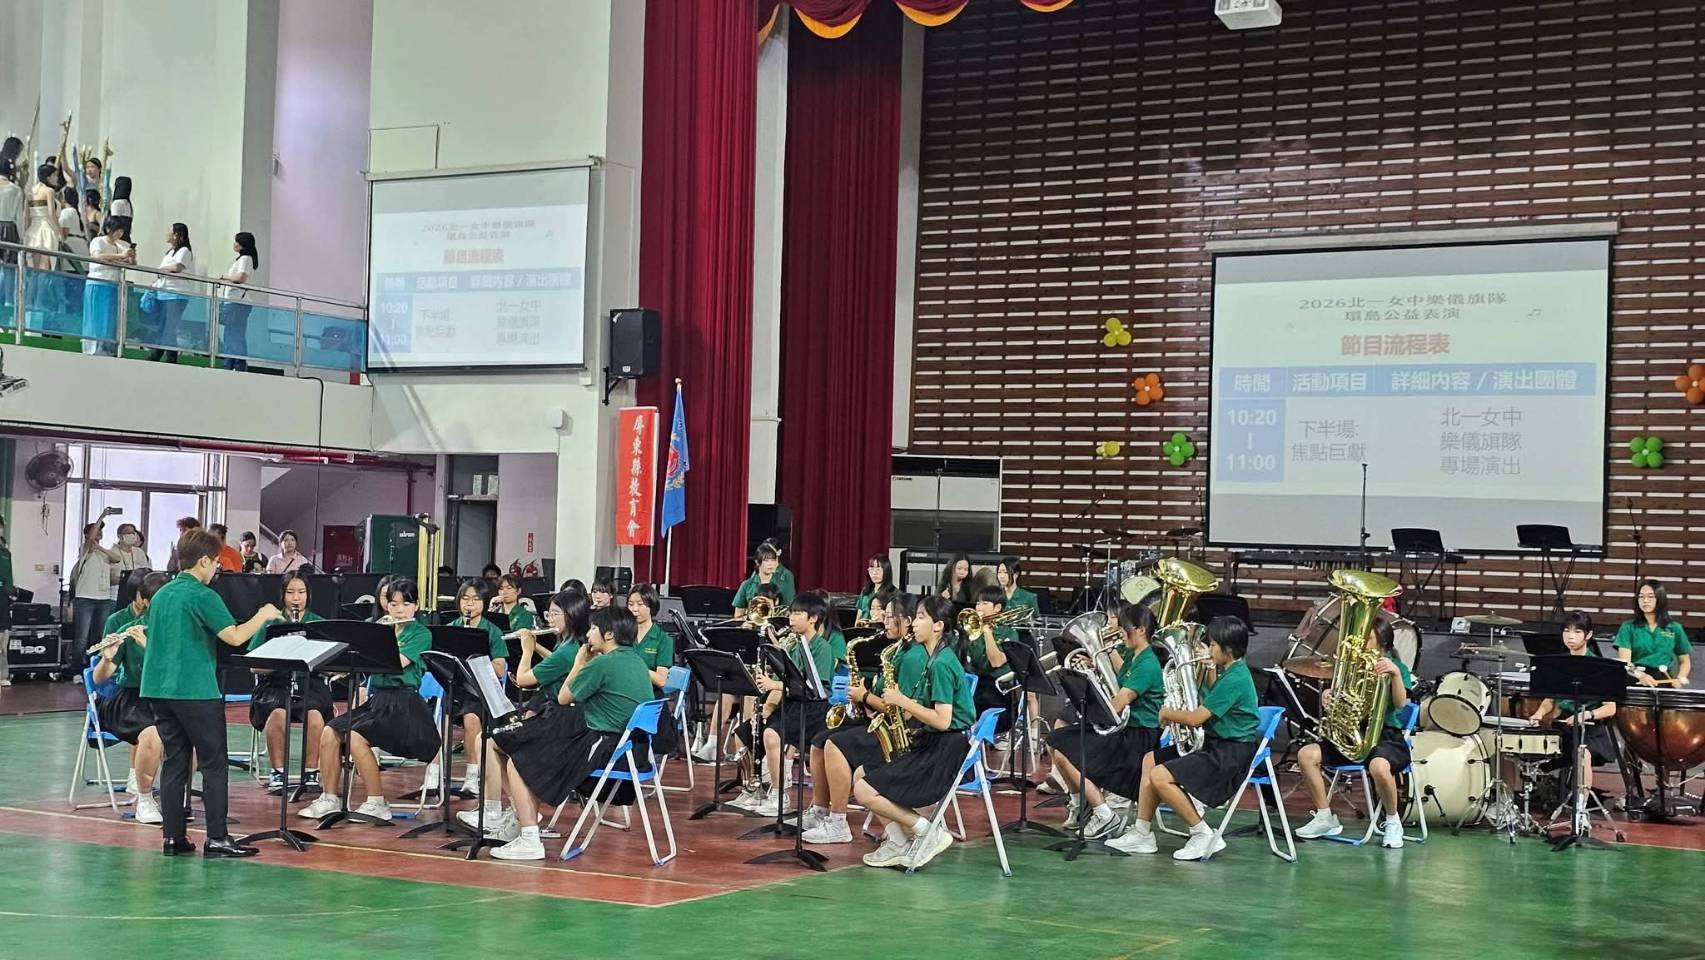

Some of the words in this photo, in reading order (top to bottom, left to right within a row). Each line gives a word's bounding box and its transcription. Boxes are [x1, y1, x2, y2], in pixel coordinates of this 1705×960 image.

[380, 302, 408, 314] 10:20
[1298, 291, 1507, 310] 2026北一女中樂儀旗隊
[1344, 307, 1461, 321] 環島公益表演
[1340, 333, 1451, 356] 節目流程表
[1234, 373, 1271, 392] 時間
[1291, 372, 1368, 393] 活動項目
[1391, 370, 1471, 391] 詳細內容
[1493, 369, 1577, 391] 演出團體
[1227, 409, 1277, 426] 10:20
[1440, 407, 1522, 428] 北一女中
[1298, 419, 1360, 439] 下半場:
[1440, 431, 1523, 452] 樂儀旗隊
[1291, 442, 1367, 462] 焦點巨獻
[1226, 454, 1276, 472] 11:00
[1440, 455, 1521, 476] 專場演出
[626, 414, 645, 539] 屏東縣教育會
